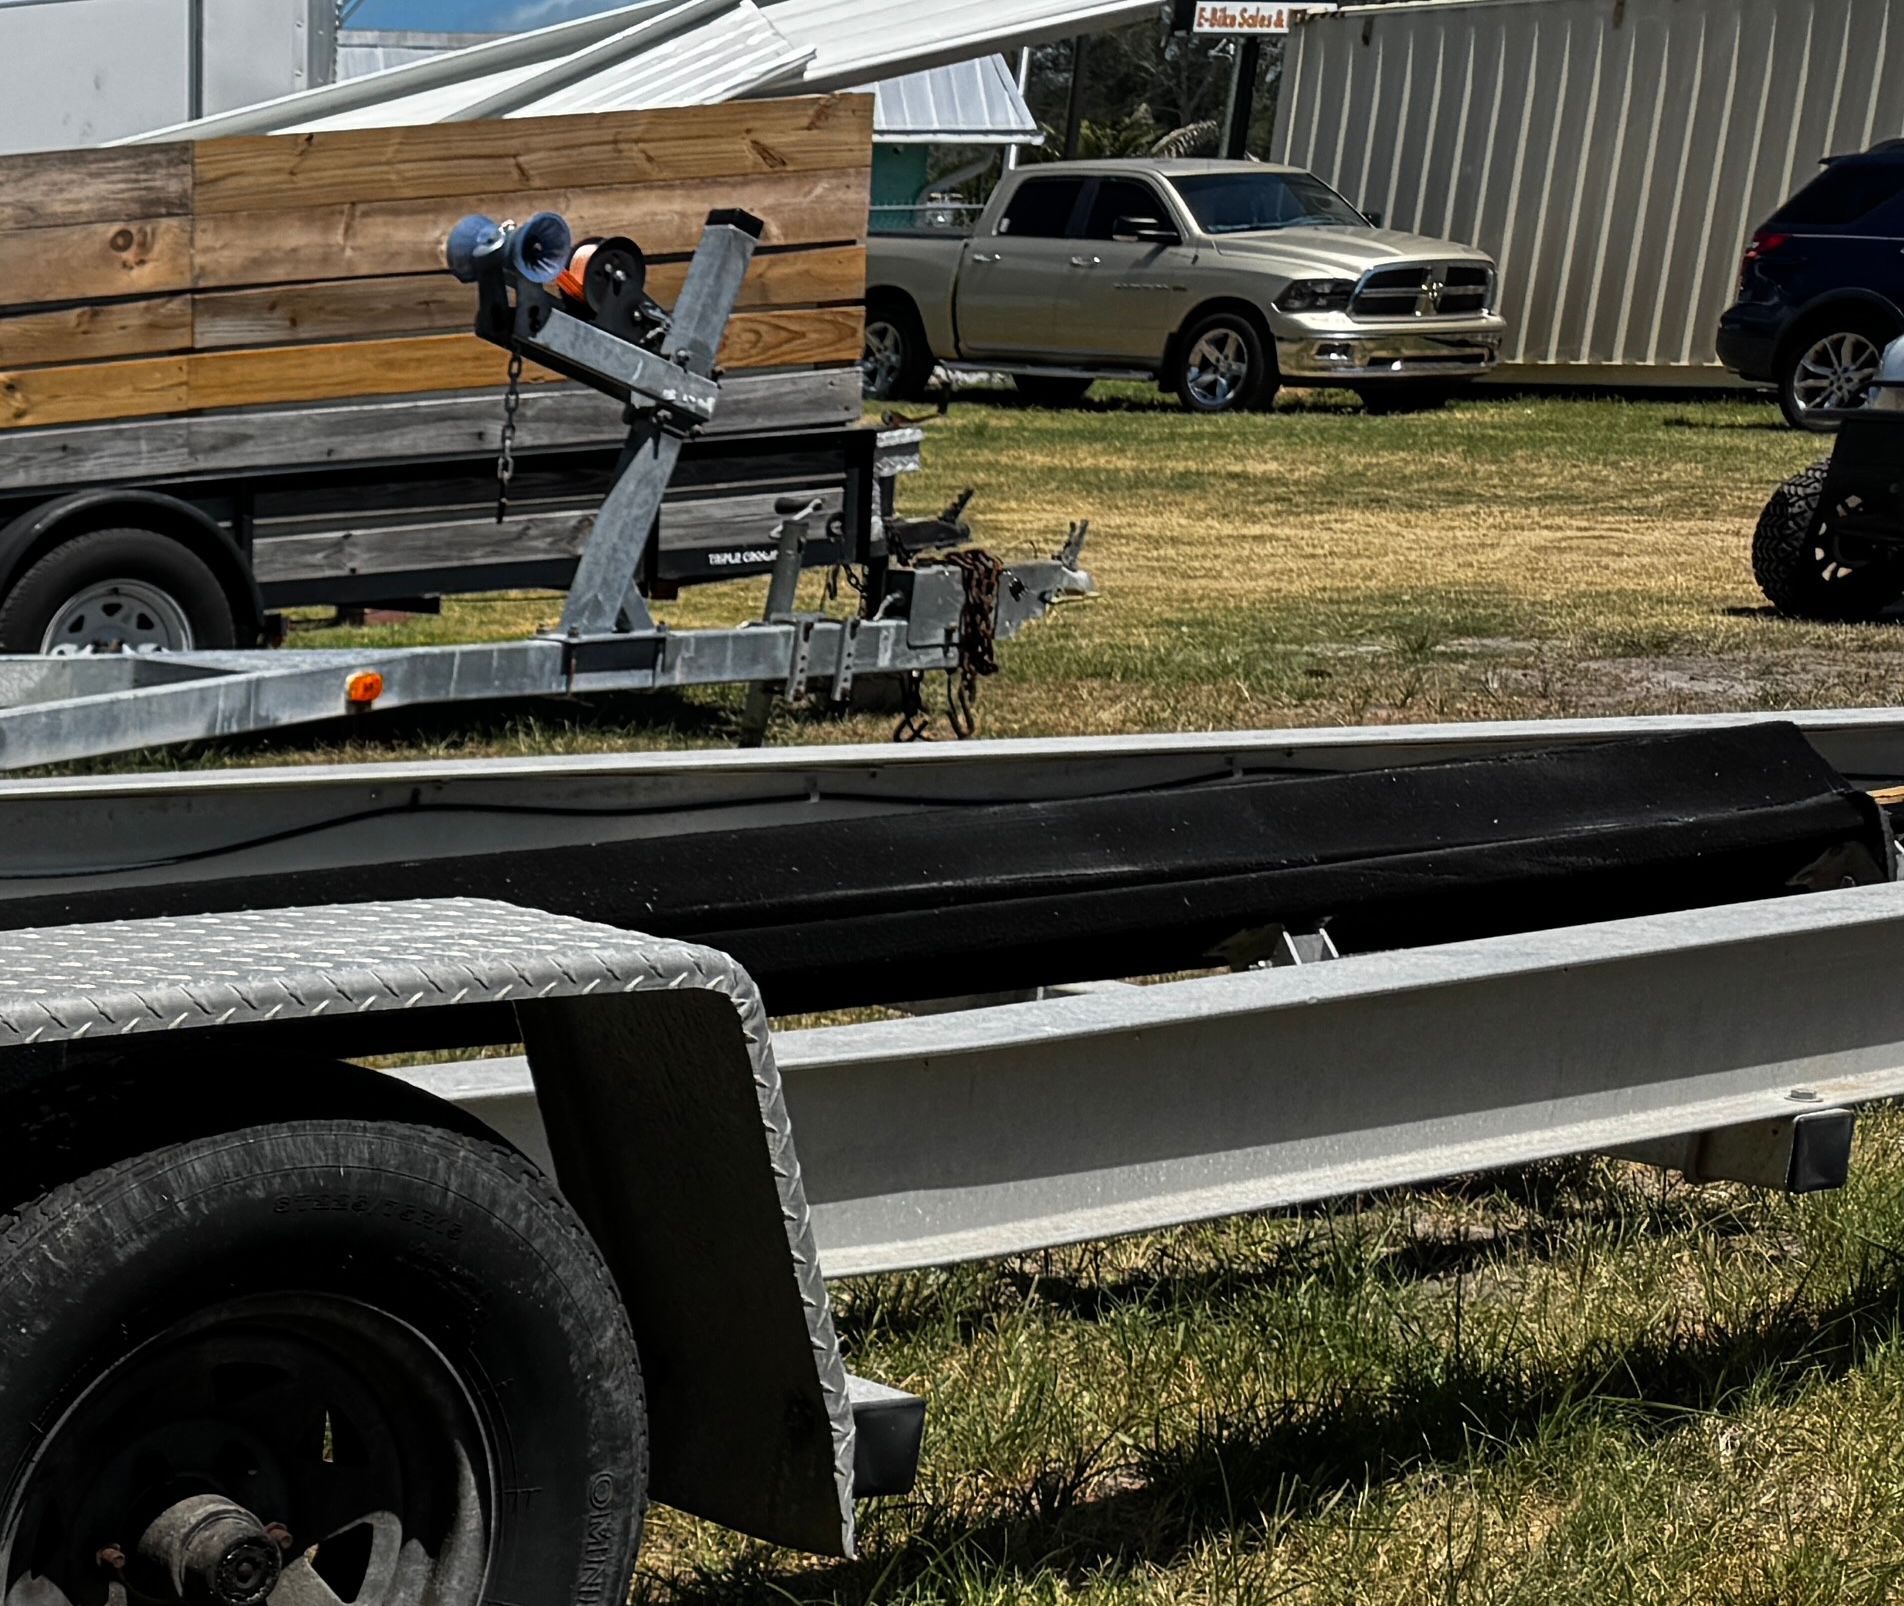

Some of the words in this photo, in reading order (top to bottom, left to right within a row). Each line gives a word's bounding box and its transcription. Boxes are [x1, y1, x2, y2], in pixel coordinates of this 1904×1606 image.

[1196, 6, 1237, 28] E-Bike
[1238, 6, 1273, 28] Sales
[1274, 8, 1284, 28] &
